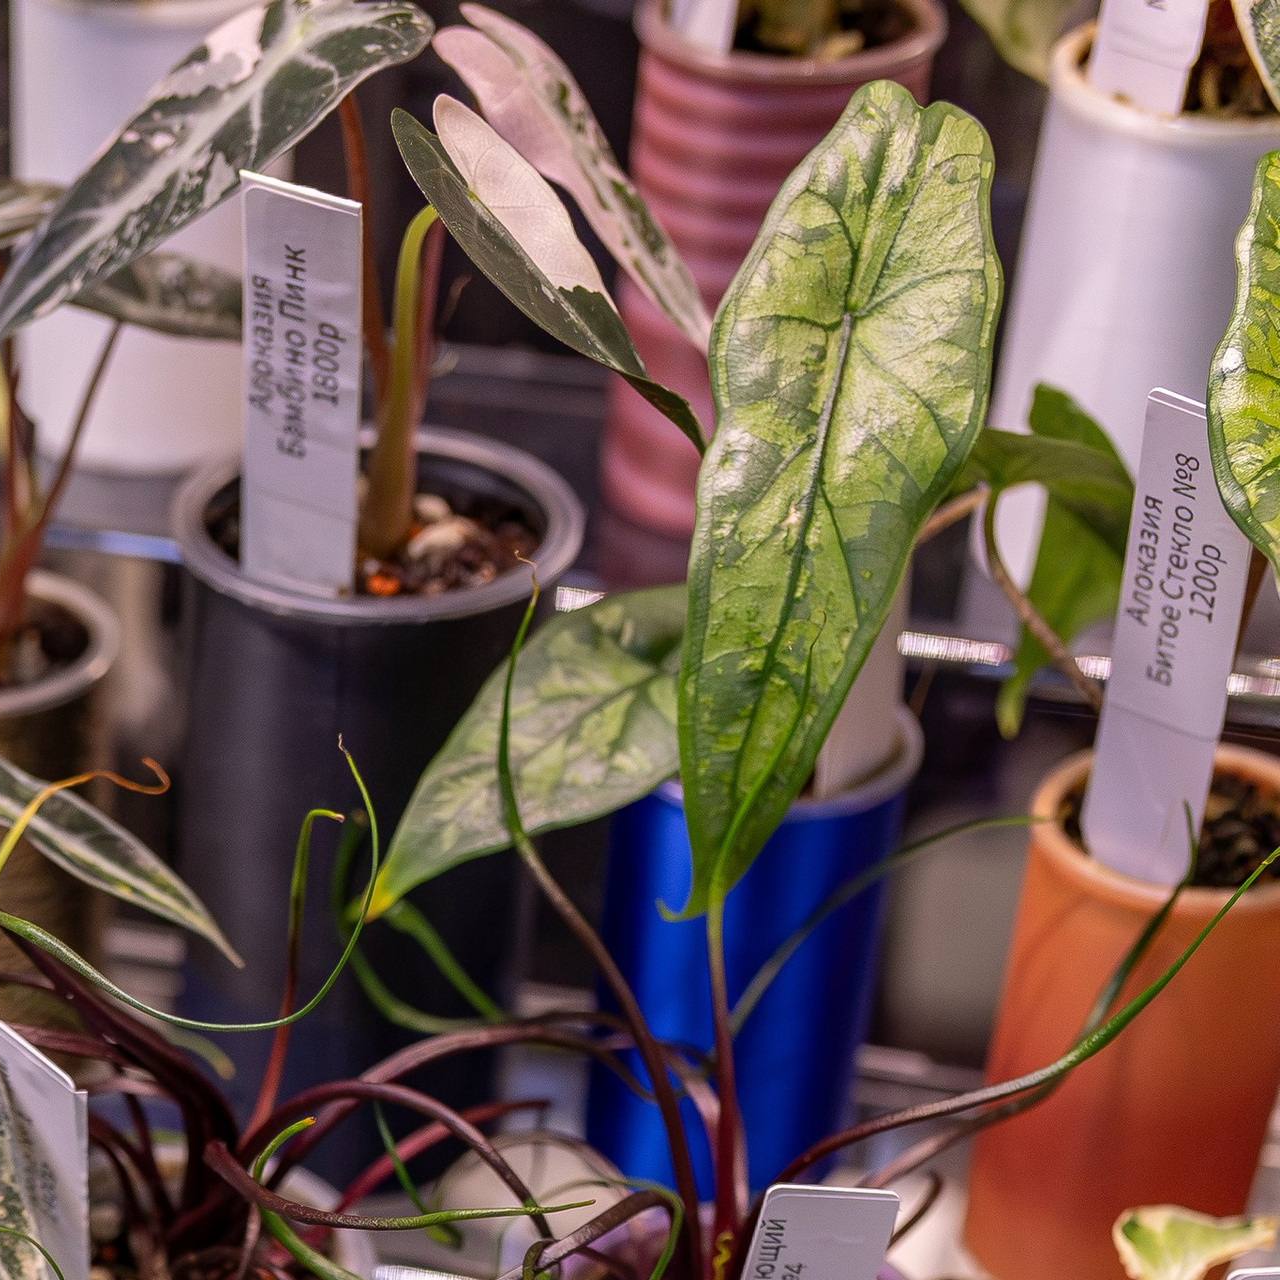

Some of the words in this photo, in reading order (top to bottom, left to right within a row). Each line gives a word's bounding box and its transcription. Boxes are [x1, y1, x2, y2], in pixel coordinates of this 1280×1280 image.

[278, 243, 307, 323] Пинк
[249, 274, 274, 417] Алоказия
[311, 321, 347, 406] 1800р
[276, 329, 307, 459] Бамбино
[1172, 452, 1200, 501] №8
[1124, 494, 1163, 627] Алоказия
[1159, 505, 1194, 601] Стекло
[1189, 543, 1227, 624] 1200р
[1145, 604, 1182, 687] Битое
